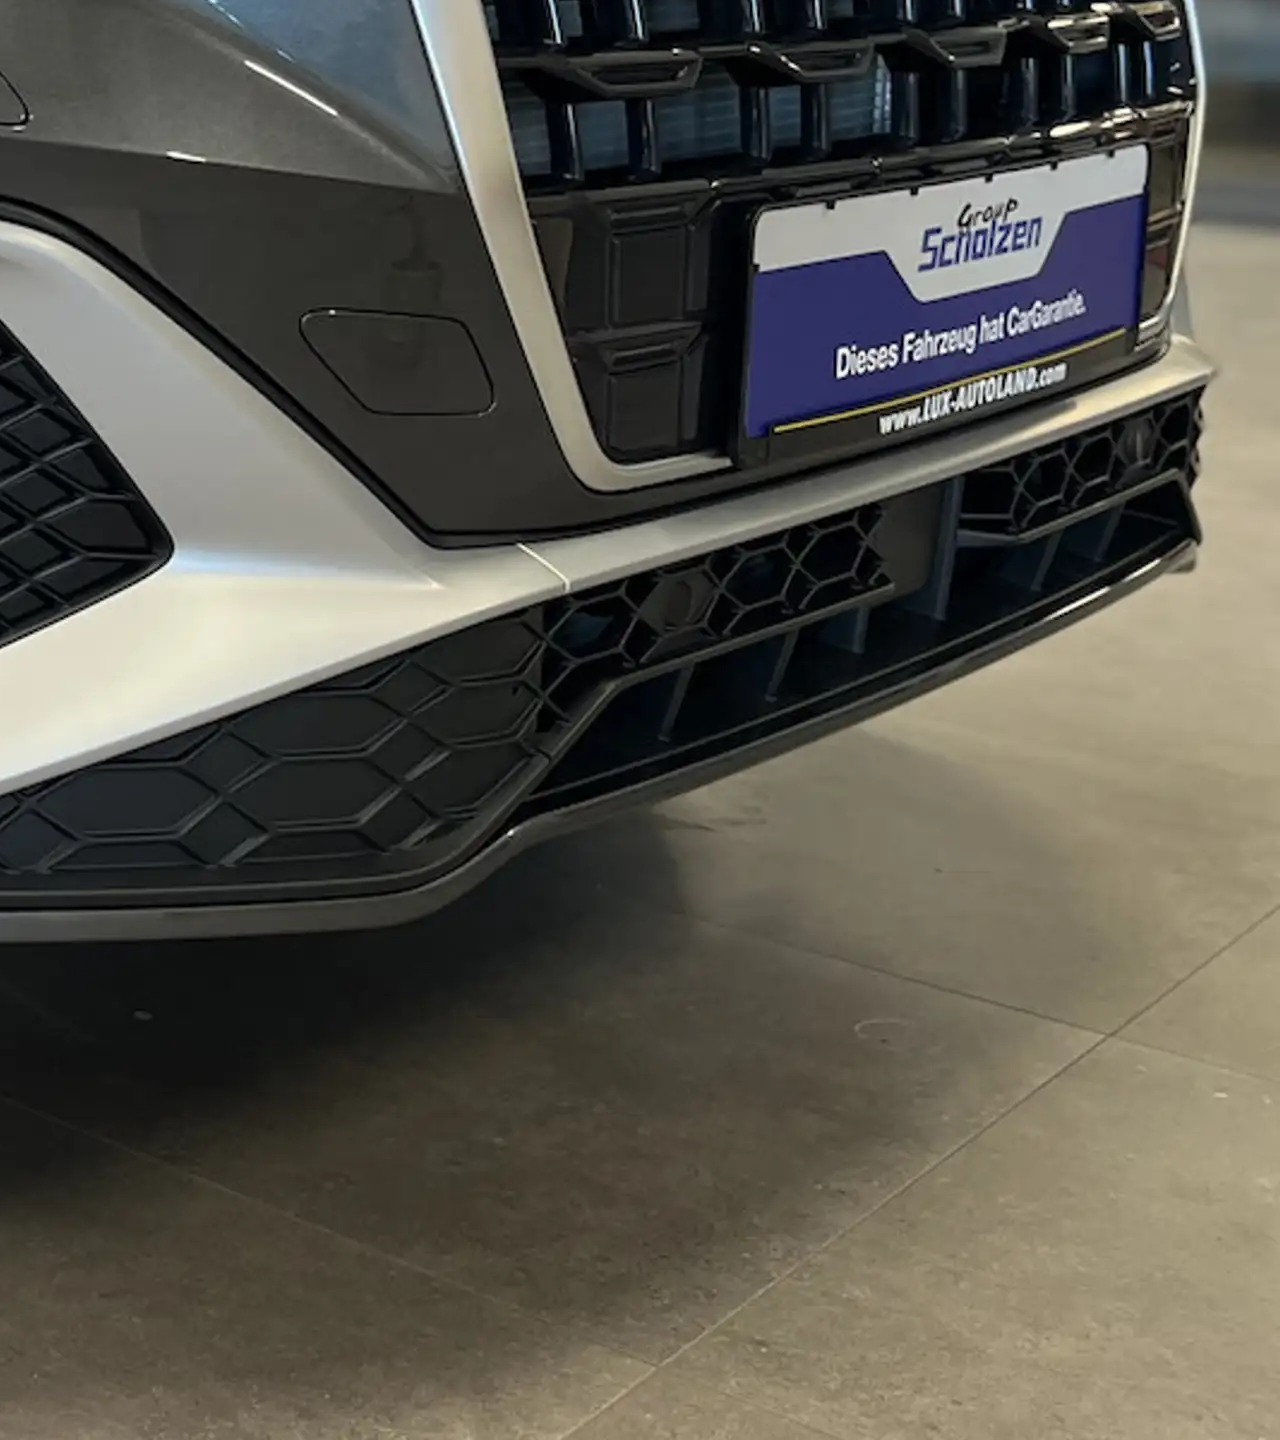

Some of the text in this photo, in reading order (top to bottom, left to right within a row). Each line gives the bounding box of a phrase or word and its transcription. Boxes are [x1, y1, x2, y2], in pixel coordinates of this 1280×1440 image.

[917, 215, 1044, 273] Scholzen
[957, 197, 1019, 228] Group
[835, 287, 1087, 380] Dieses Fahrzeug hat CarGarantie.
[878, 362, 1068, 435] www.LUX-AUTOLAND.com
